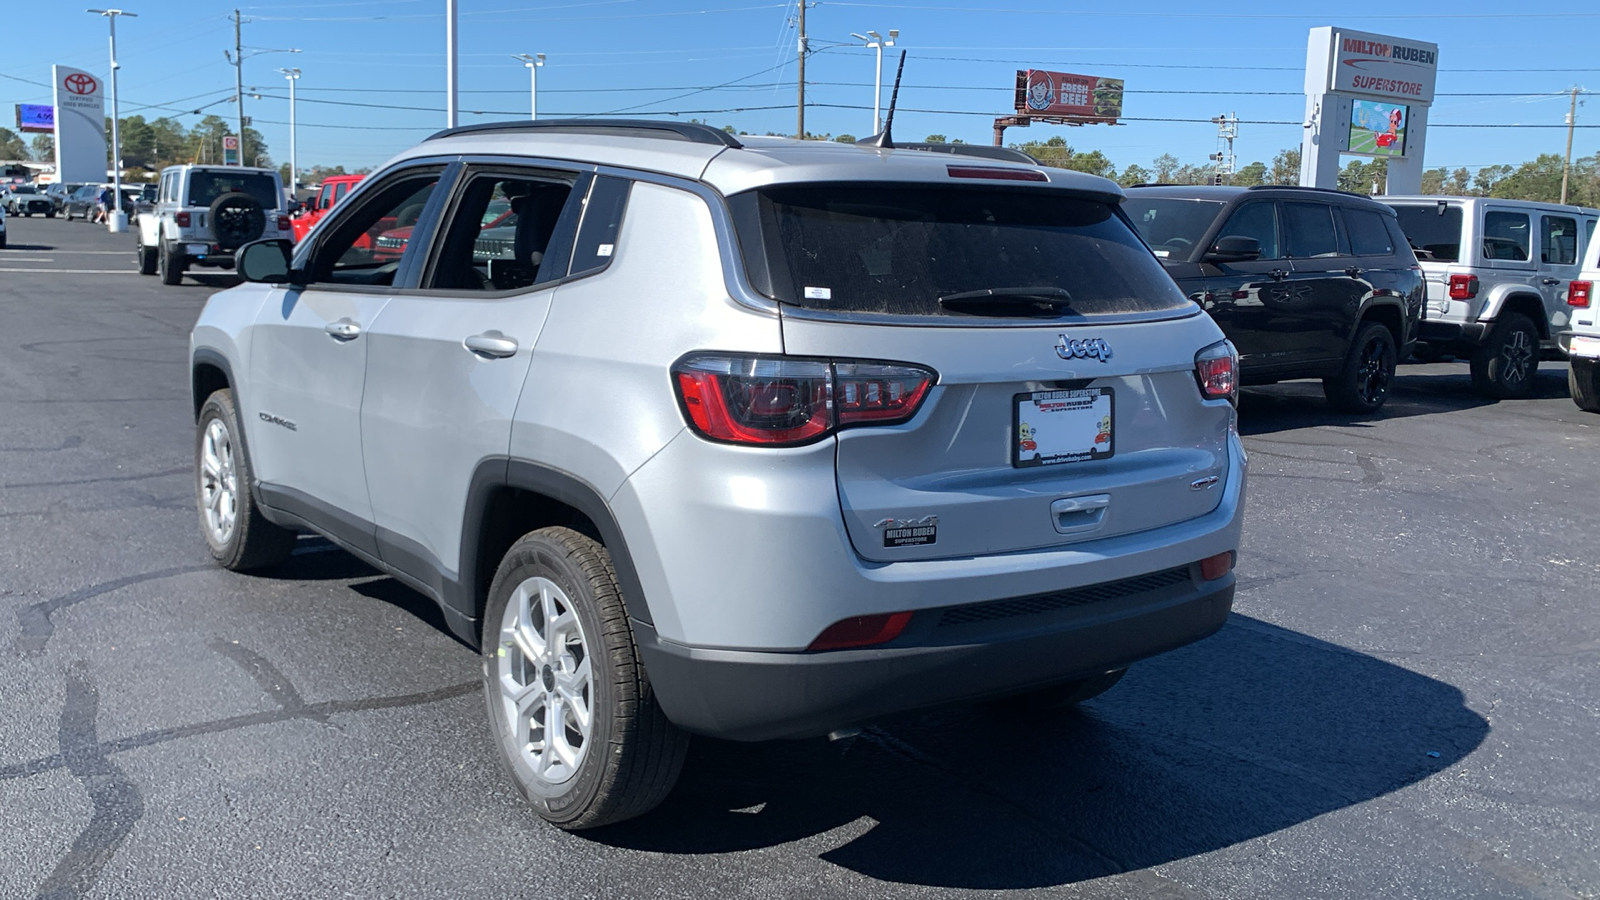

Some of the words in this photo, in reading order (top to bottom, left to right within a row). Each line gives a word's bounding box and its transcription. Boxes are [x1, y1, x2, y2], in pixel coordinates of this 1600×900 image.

[1343, 38, 1391, 58] MILTON
[1392, 45, 1435, 64] RUBEN
[1061, 82, 1088, 94] FRESH
[1352, 75, 1423, 96] SUPERSTORE
[1060, 92, 1088, 106] BEEF
[1054, 333, 1113, 363] Jeep
[1032, 391, 1051, 401] MILTON
[1052, 390, 1069, 399] RUBEN
[1069, 388, 1101, 398] SUPERSTORE
[886, 528, 912, 539] MILTON
[912, 526, 935, 537] RUBEN
[894, 536, 928, 544] SUPERSTORE
